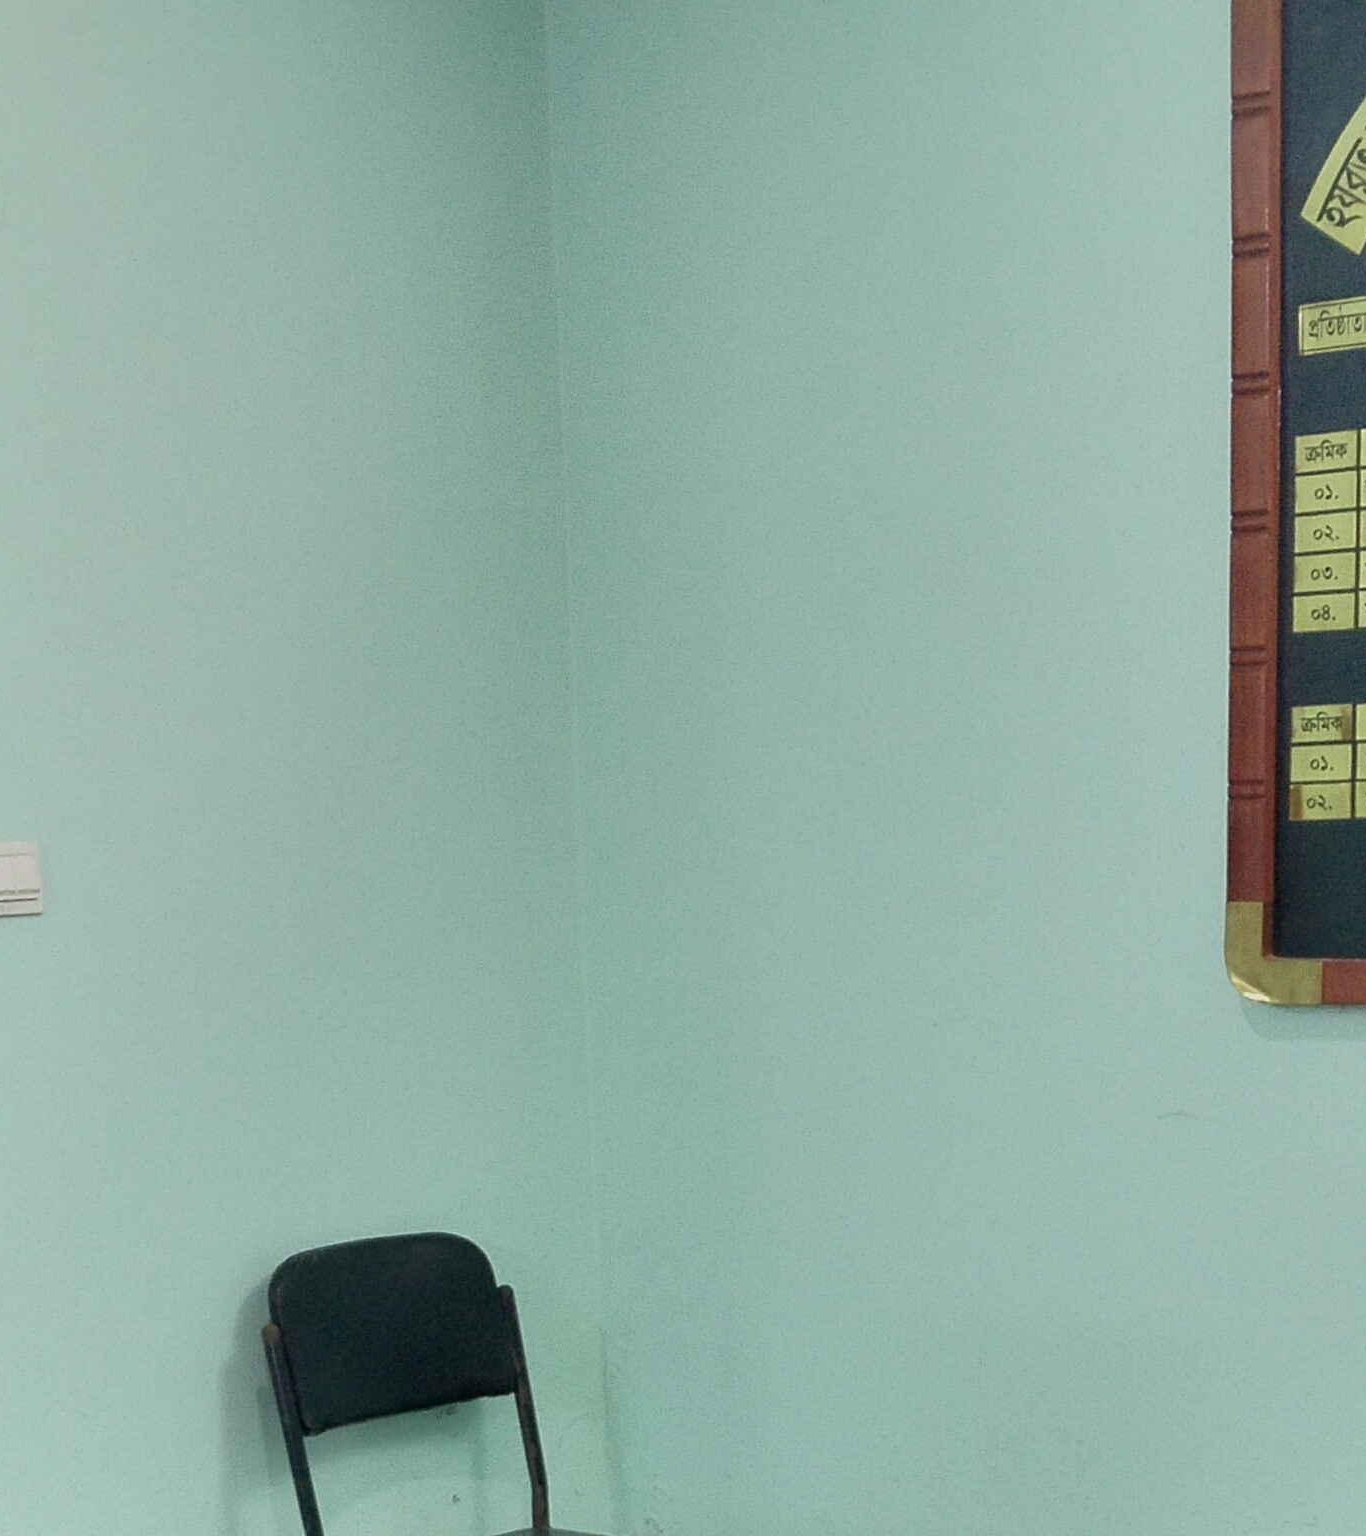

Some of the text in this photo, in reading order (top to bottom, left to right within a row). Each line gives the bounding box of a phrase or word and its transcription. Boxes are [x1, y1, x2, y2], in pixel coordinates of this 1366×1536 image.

[1304, 440, 1348, 462] ক্রমিক
[1314, 484, 1339, 500] ০১.
[1313, 524, 1339, 541] ০২.
[1310, 567, 1338, 581] ০৩.
[1311, 607, 1336, 621] ০৪.
[1301, 711, 1344, 734] ক্রমিক
[1310, 757, 1334, 771] ০১.
[1306, 796, 1332, 812] ০২.
